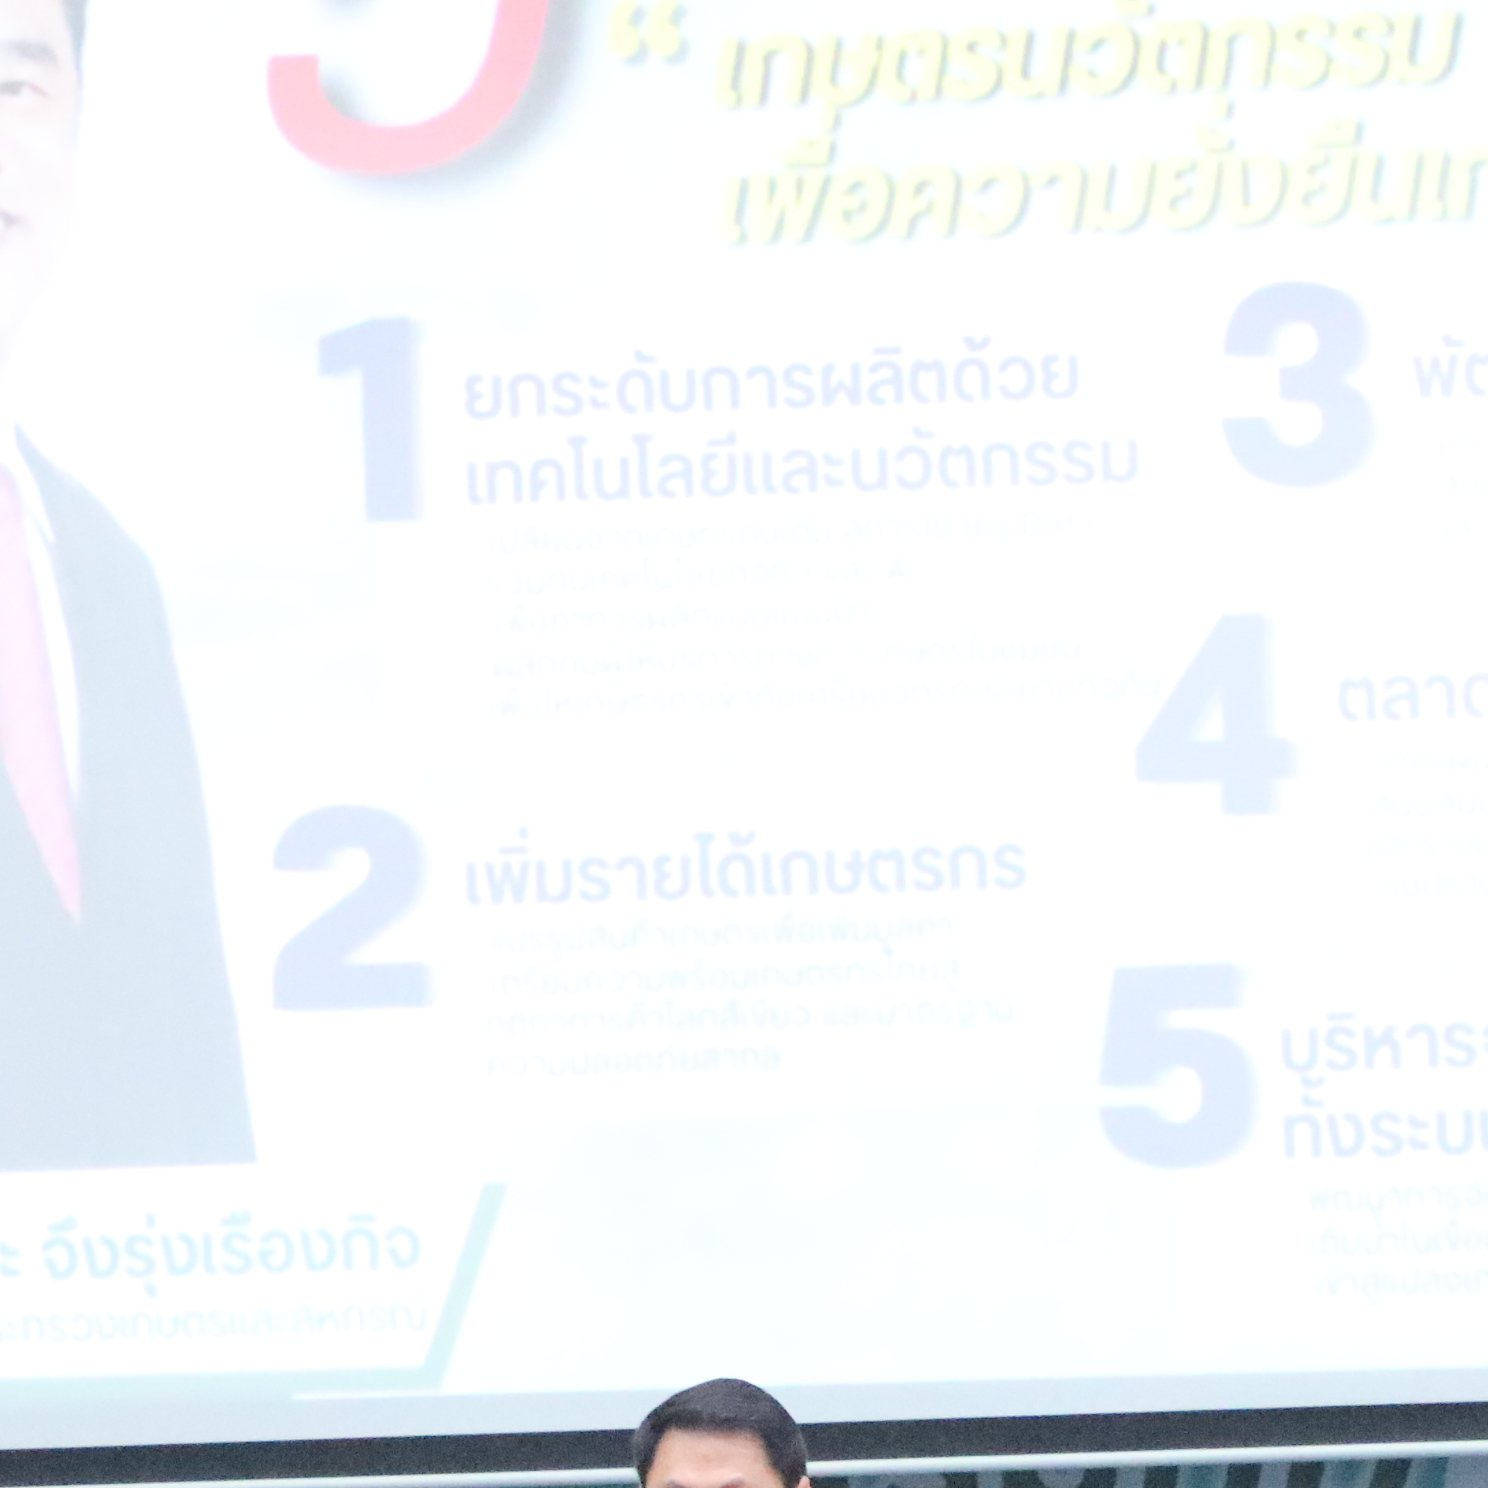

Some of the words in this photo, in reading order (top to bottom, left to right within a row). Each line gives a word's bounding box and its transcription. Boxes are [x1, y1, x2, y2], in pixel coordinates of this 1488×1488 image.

[316, 315, 422, 521] 1
[463, 335, 1080, 420] ยกระดับการผลิตด้วย
[464, 425, 1140, 505] เทคโนโลยีและนวัตกรรม
[1221, 280, 1378, 488] 3
[1133, 612, 1298, 815] 4
[274, 804, 431, 1011] 2
[465, 827, 1029, 905] เพิ่มรายได้เกษตรกร
[1098, 962, 1260, 1169] 5
[42, 1210, 423, 1298] จึงรุ่งเรืองกิจ
